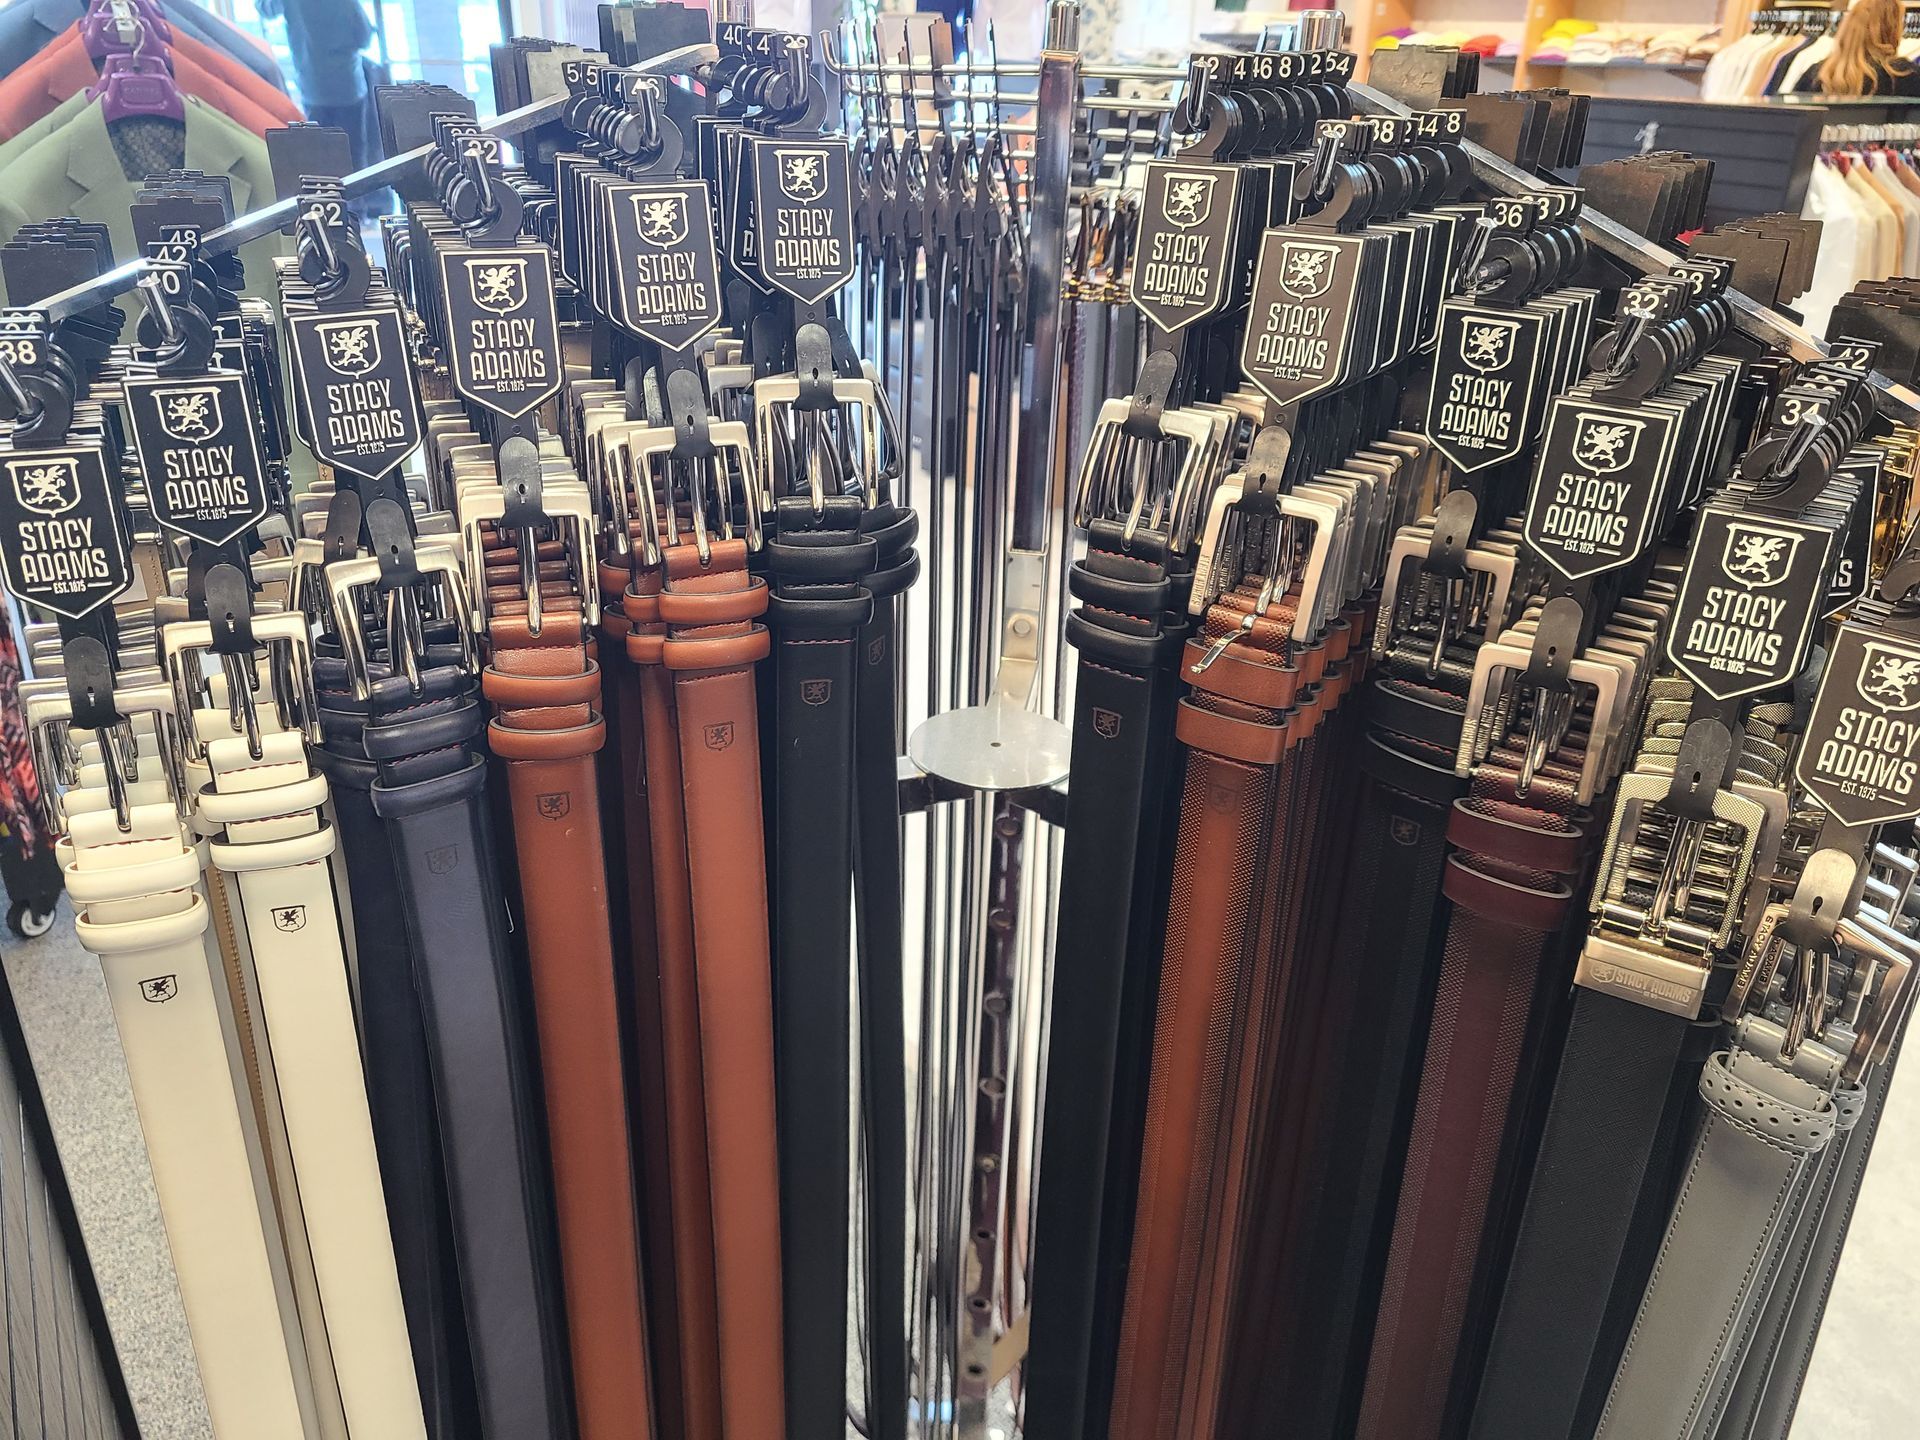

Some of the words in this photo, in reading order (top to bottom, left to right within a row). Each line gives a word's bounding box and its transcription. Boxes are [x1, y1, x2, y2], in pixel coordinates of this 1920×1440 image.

[1326, 51, 1350, 76] 54
[777, 207, 834, 237] STACY
[1493, 202, 1523, 228] 36
[775, 239, 840, 267] ADAMS
[1152, 232, 1211, 265] STACY
[637, 252, 696, 283] STACY
[1143, 262, 1209, 297] ADAMS
[636, 282, 707, 315] ADAMS
[471, 318, 535, 349] STACY
[1266, 302, 1331, 338] STACY
[470, 349, 546, 381] ADAMS
[1256, 333, 1328, 370] ADAMS
[327, 378, 391, 414] STACY
[1449, 373, 1513, 409] STACY
[328, 409, 405, 446] ADAMS
[1440, 402, 1512, 441] ADAMS
[163, 445, 234, 479] STACY
[165, 475, 249, 510] ADAMS
[1556, 473, 1632, 513] STACY
[18, 517, 92, 552] STACY
[1542, 504, 1629, 546] ADAMS
[20, 547, 110, 583] ADAMS
[1702, 586, 1787, 631] STACY
[1686, 618, 1783, 666] ADAMS
[1834, 707, 1920, 758] STACY
[1816, 740, 1918, 795] ADAMS
[1840, 780, 1857, 796] EST.
[1615, 967, 1651, 991] STACY
[1649, 977, 1692, 1004] ADAMS
